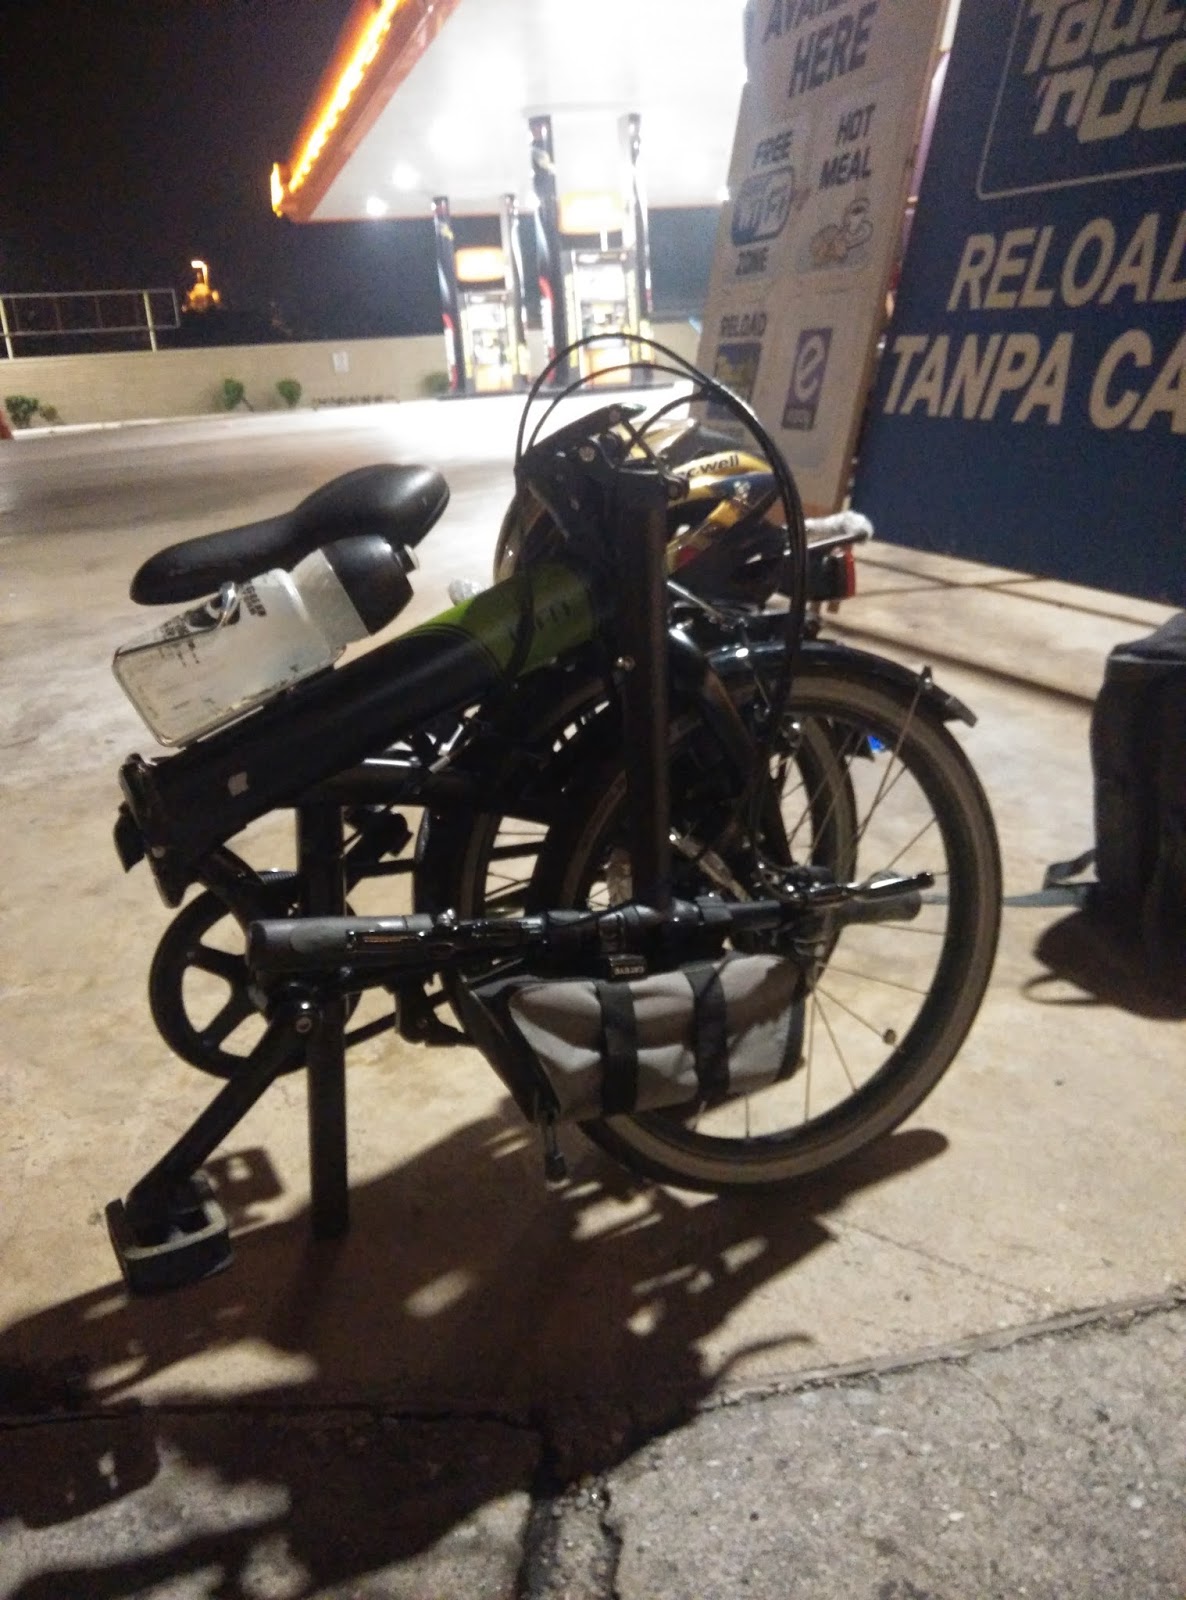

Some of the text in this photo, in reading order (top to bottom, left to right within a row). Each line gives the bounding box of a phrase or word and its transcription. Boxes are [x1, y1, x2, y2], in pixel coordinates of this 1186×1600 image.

[789, 1, 878, 98] HERE
[835, 103, 877, 146] HOT
[752, 130, 793, 169] FREE
[818, 146, 873, 190] MEAL
[882, 332, 1075, 426] TANPA
